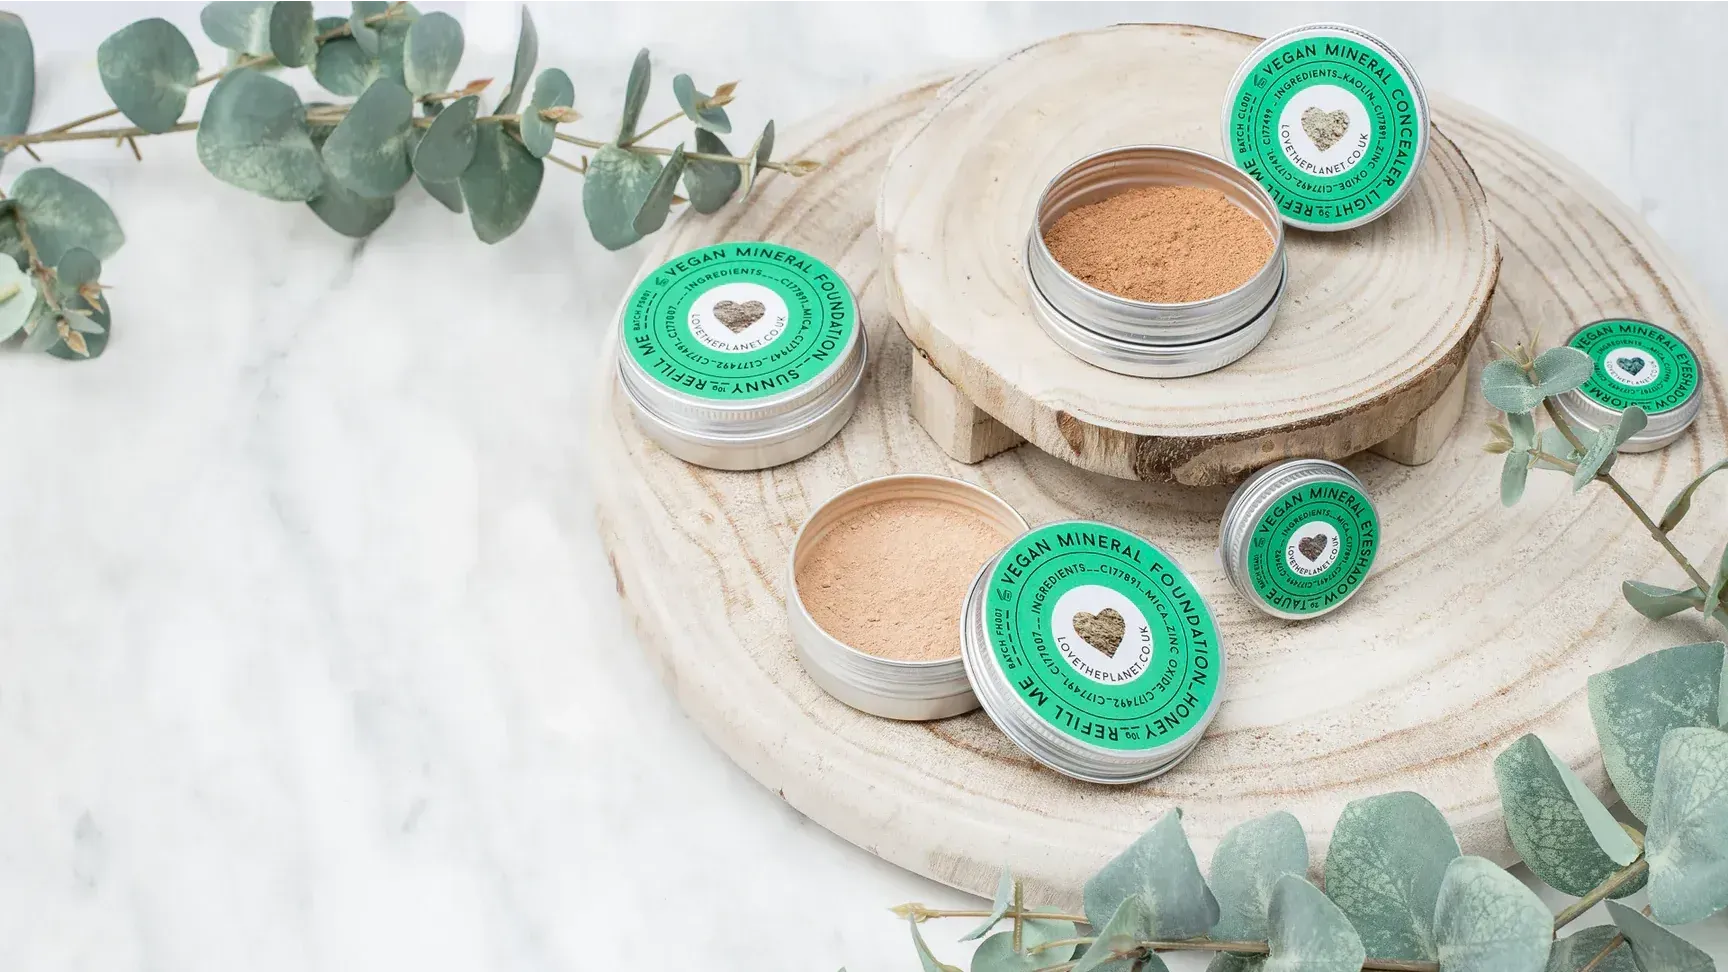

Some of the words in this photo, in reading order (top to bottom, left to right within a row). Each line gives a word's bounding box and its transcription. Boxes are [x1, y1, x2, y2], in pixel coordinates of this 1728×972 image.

[1262, 43, 1316, 75] VEGAN
[1325, 43, 1392, 85] MINERAL
[1237, 91, 1252, 120] CL001
[1236, 123, 1247, 154] BATCH
[1281, 124, 1368, 175] LOVETHEPLANET.CO.UK
[1382, 88, 1413, 187] CONCEALER
[1243, 158, 1264, 182] ME
[1267, 183, 1313, 217] REFILL
[1335, 188, 1381, 218] LIGHT
[664, 249, 726, 276] VEGAN
[735, 247, 812, 274] MINERAL
[632, 309, 641, 331] BATCH
[811, 273, 845, 361] FOUNDATION
[634, 334, 656, 356] ME
[691, 313, 785, 354] LOVETHEPLANET.CO.UK
[653, 357, 707, 390] REFILL
[731, 369, 800, 394] SUNNY
[1574, 325, 1613, 349] VEGAN
[1618, 324, 1677, 351] MINERAL
[1655, 352, 1693, 409] EYESHADOW
[1258, 491, 1303, 532] VEGAN
[1309, 487, 1365, 518] MINERAL
[1000, 538, 1052, 584] VEGAN
[1056, 532, 1141, 564] MINERAL
[1287, 535, 1339, 575] LOVETHEPLANET.CO.UK
[1324, 519, 1373, 605] EYESHADOW
[1265, 587, 1306, 611] TAUPE
[994, 608, 1004, 636] FH001
[1149, 562, 1208, 685] FOUNDATION
[998, 639, 1016, 670] BATCH
[1057, 625, 1151, 682] LOVETHEPLANET.CO.UK
[1018, 675, 1048, 707] ME
[1055, 704, 1118, 741] REFILL
[1145, 691, 1199, 739] HONEY
[1124, 731, 1140, 740] 10g
